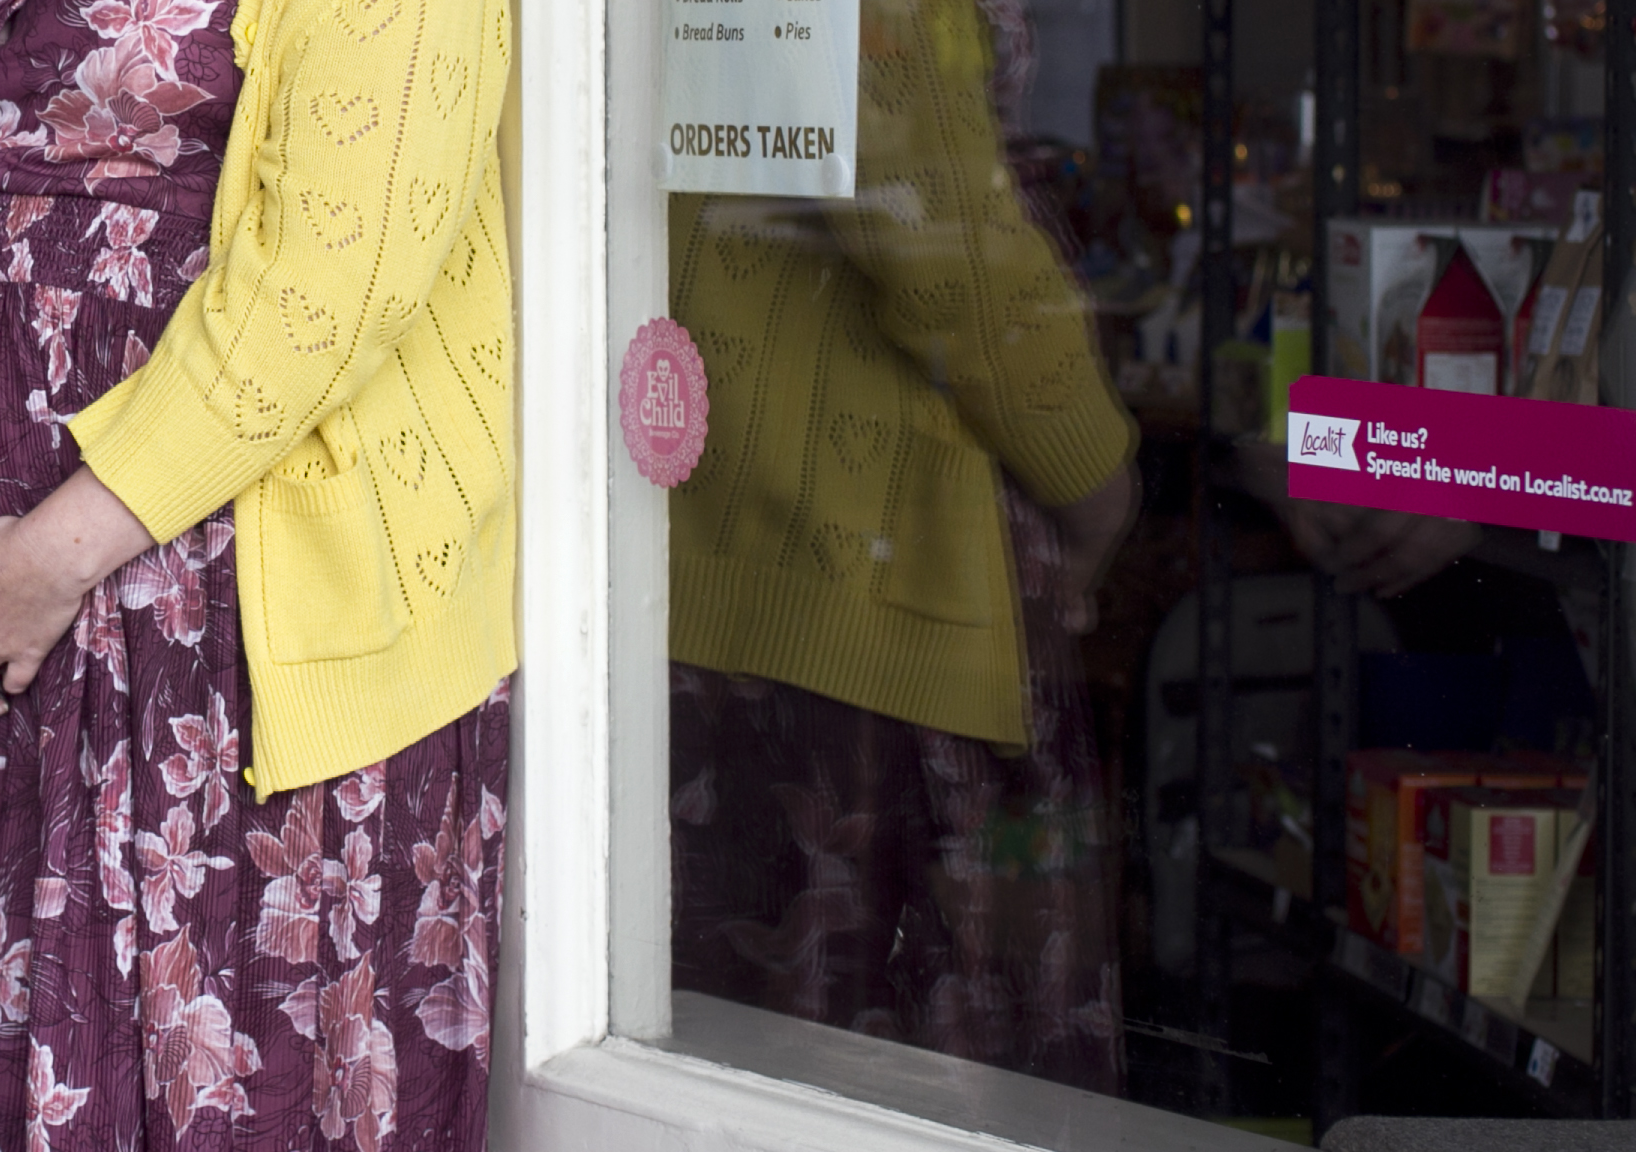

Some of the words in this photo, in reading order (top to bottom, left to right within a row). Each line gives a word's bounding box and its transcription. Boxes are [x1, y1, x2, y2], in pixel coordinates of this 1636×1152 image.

[682, 22, 714, 41] Bread
[716, 23, 744, 41] Buns
[785, 21, 811, 40] Pies
[670, 123, 752, 159] ORDERS
[757, 125, 835, 160] TAKEN
[646, 371, 679, 404] Evil
[639, 398, 685, 428] Child
[1300, 421, 1347, 458] Localist
[1367, 421, 1398, 446] Like
[1401, 428, 1428, 450] us?
[1366, 452, 1422, 479] Spread
[1424, 457, 1451, 484] the
[1454, 465, 1496, 489] word
[1500, 475, 1521, 492] on
[1525, 471, 1634, 507] Localist.co.nz
